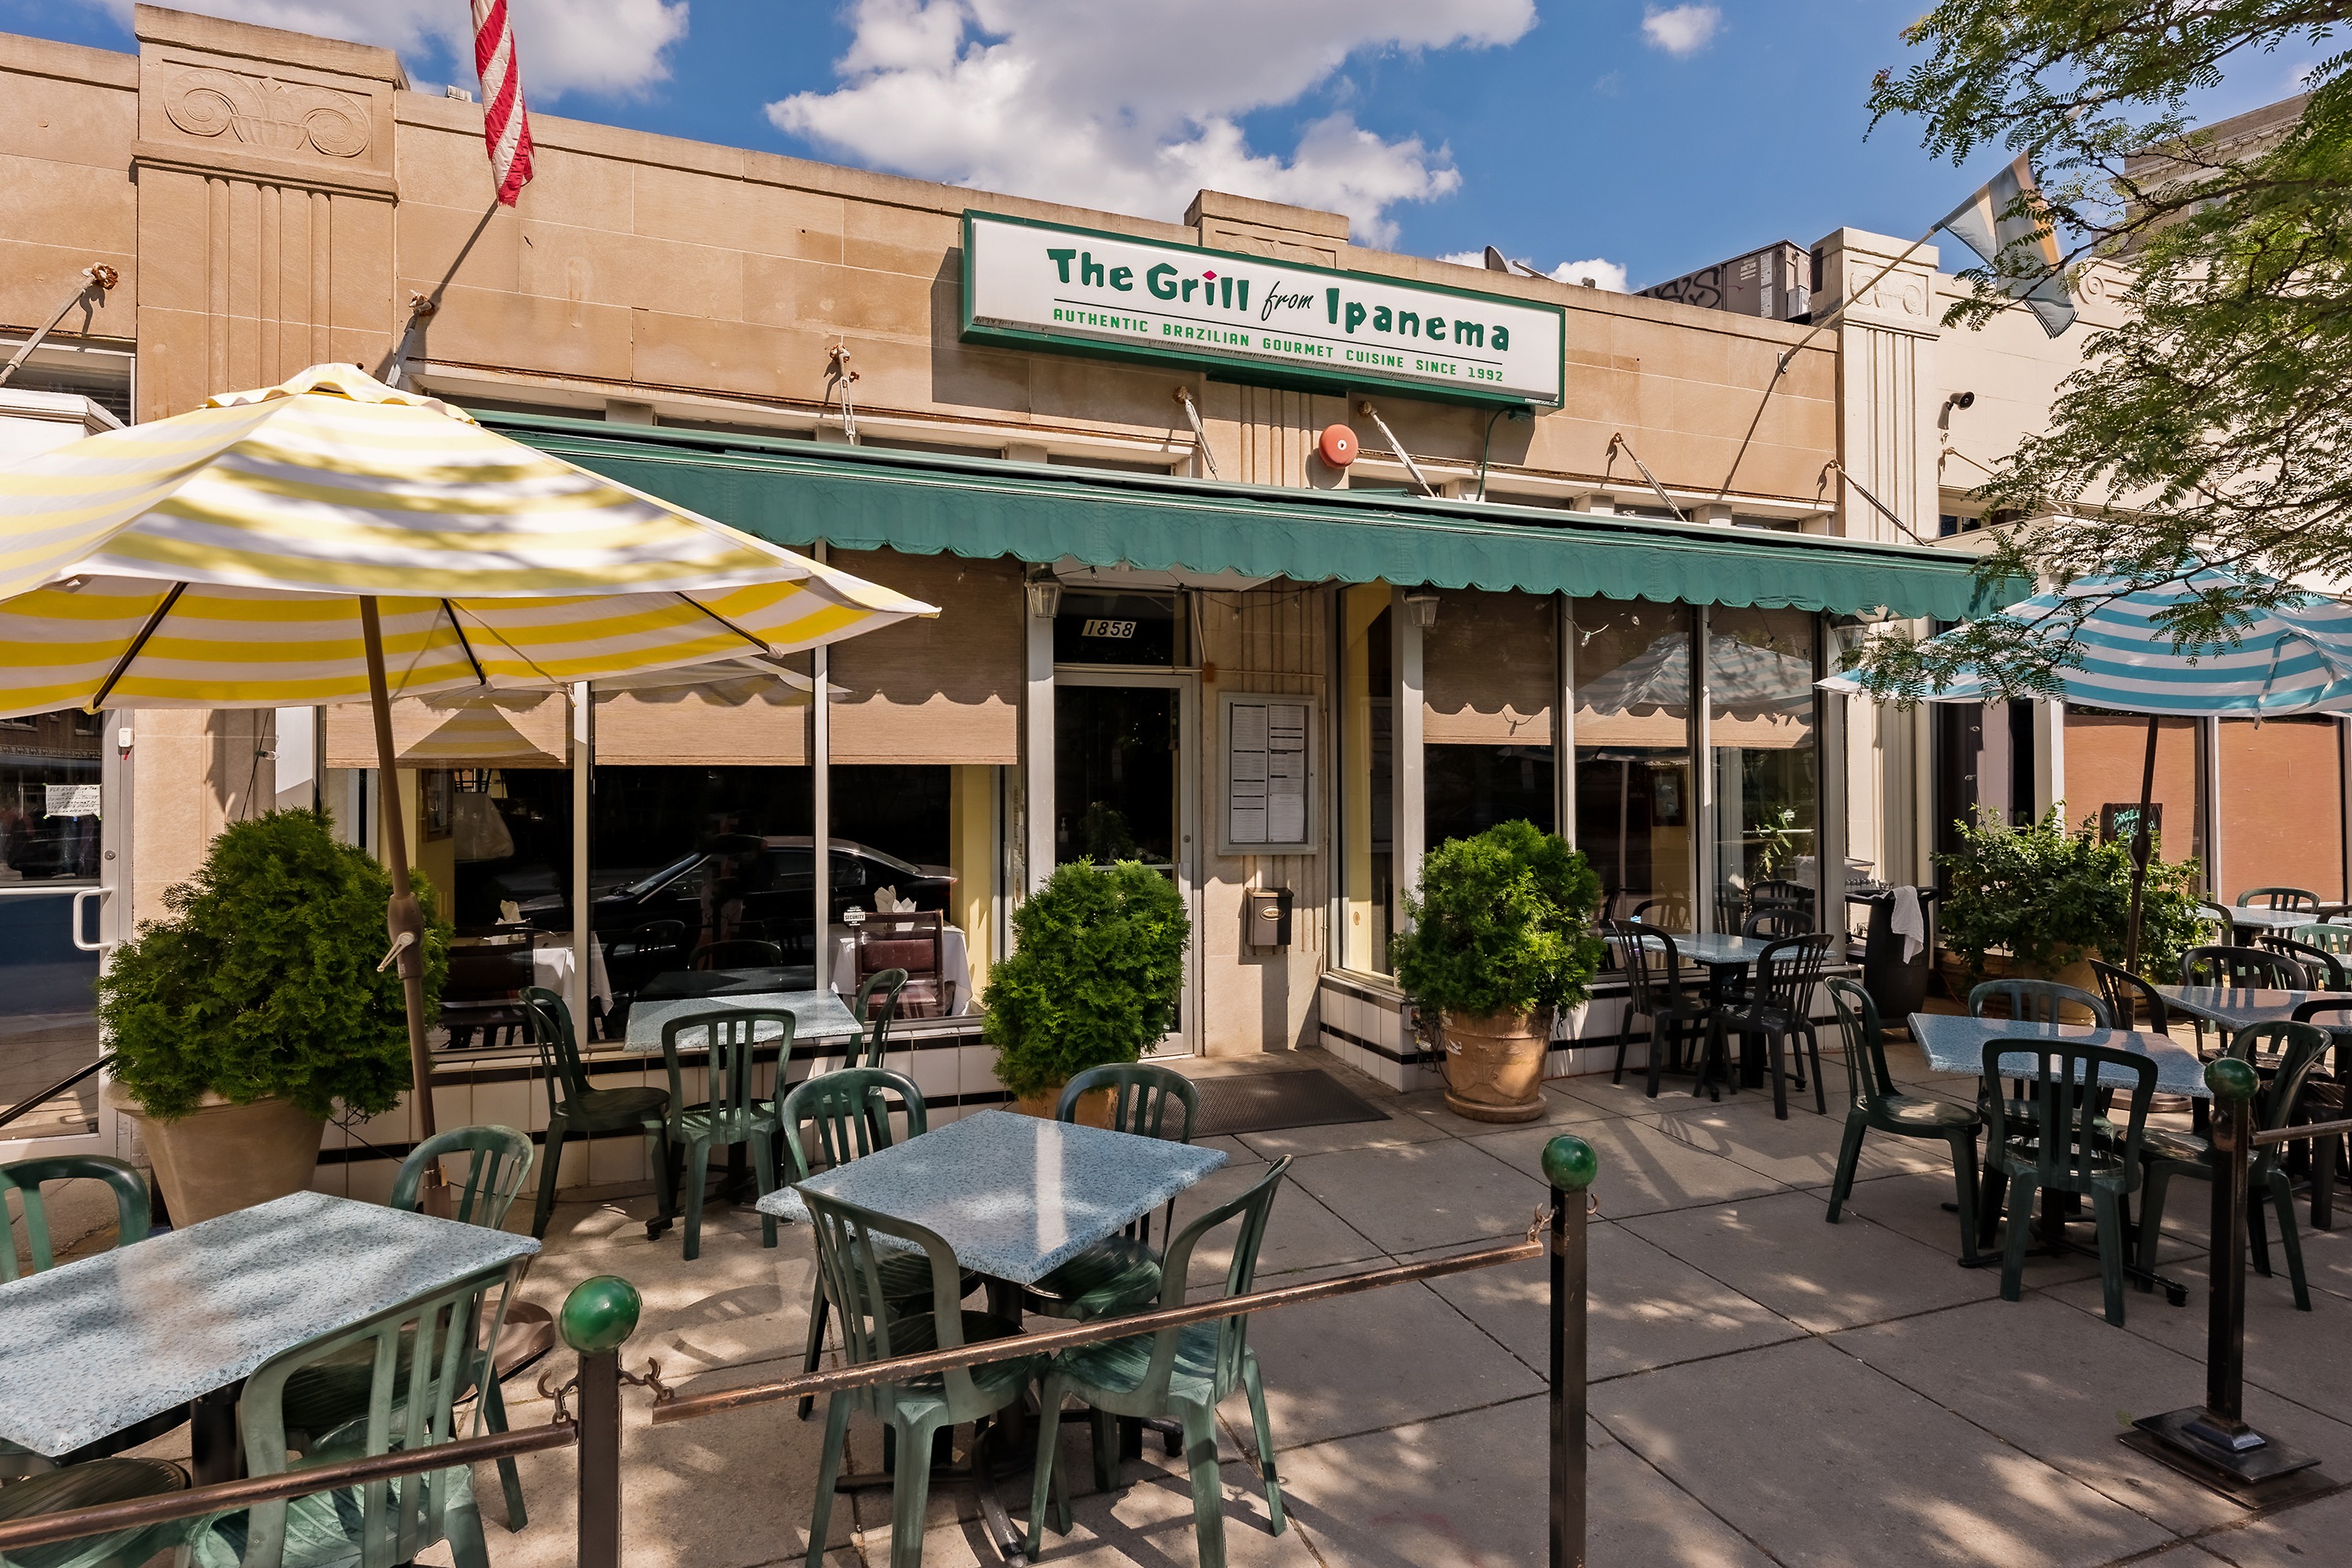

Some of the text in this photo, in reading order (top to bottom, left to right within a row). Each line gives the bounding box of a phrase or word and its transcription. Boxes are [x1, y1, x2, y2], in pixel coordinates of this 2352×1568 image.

[1046, 249, 1510, 352] The Grill from Ipanema
[1054, 308, 1503, 382] AUTHENTIC BRAZILIAN GOURMET CUISINE SINCE 1992
[1087, 620, 1134, 637] 1858
